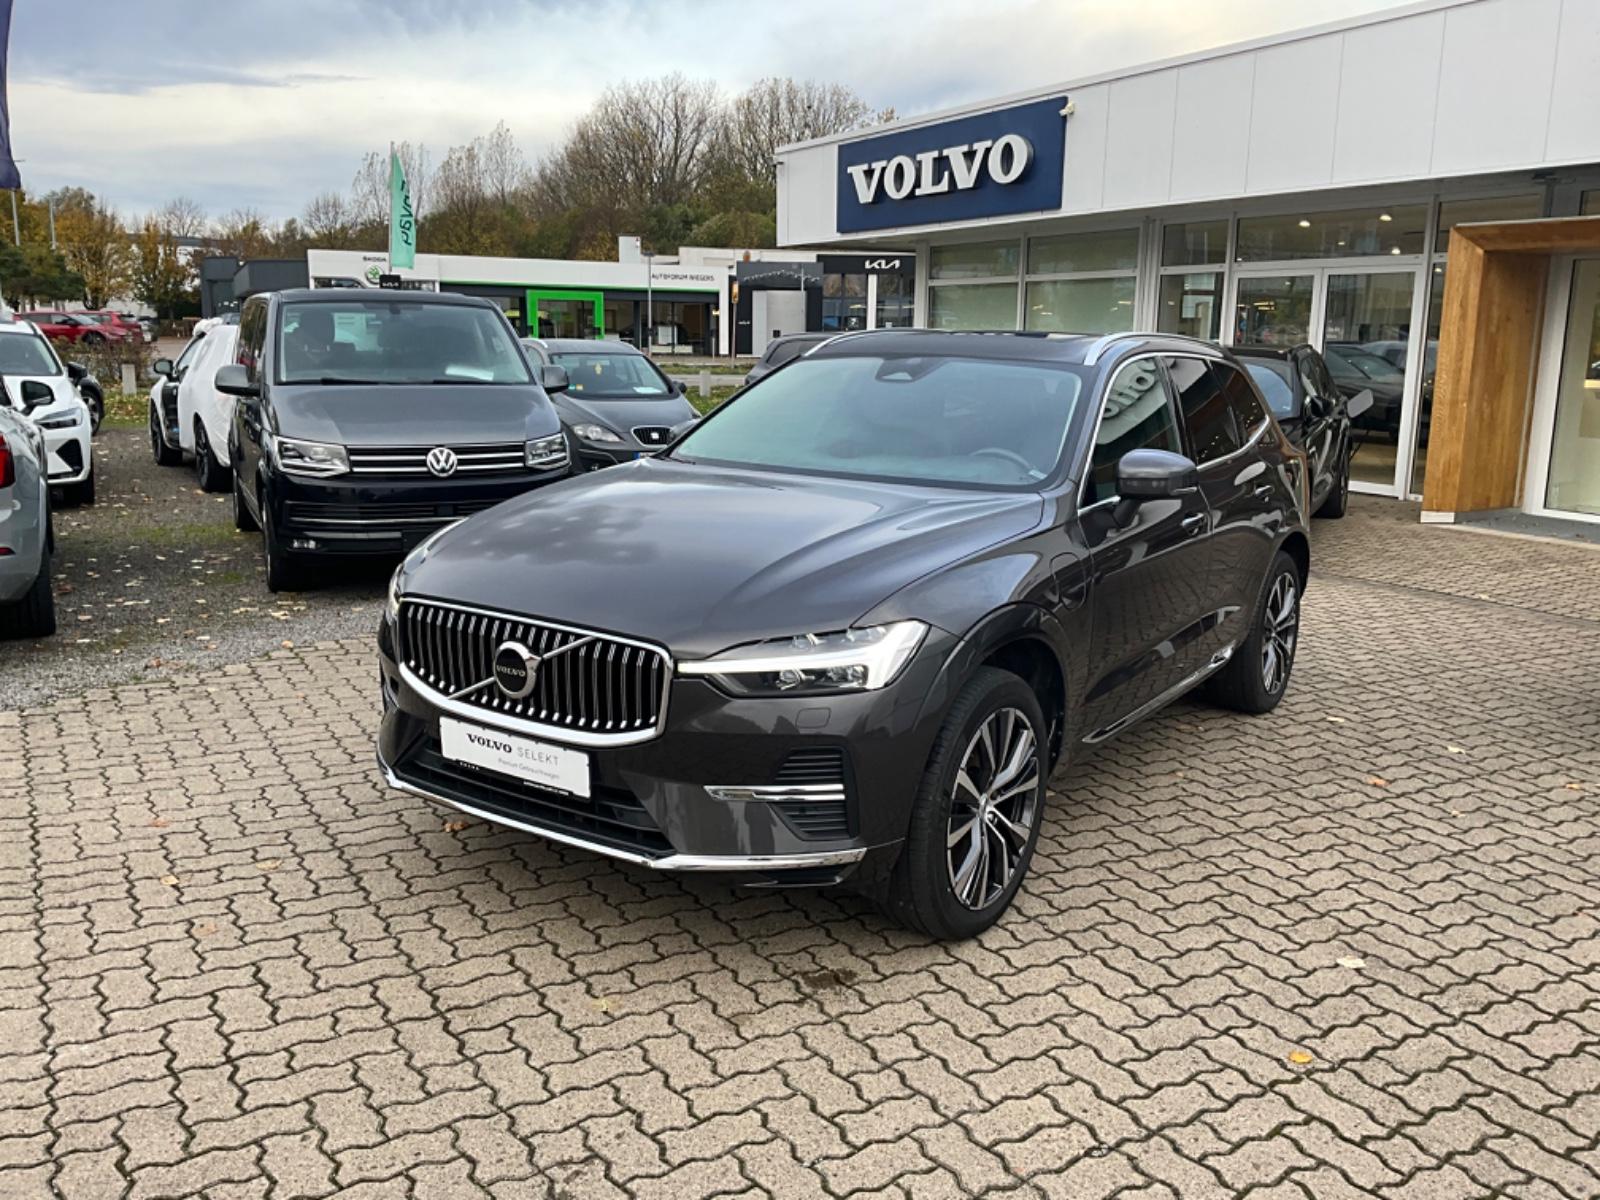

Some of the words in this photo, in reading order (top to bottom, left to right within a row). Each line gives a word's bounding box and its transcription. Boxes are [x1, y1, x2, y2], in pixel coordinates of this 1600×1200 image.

[847, 134, 1034, 204] VOLVO
[864, 259, 901, 269] KIA
[496, 664, 526, 677] VOLVO
[467, 733, 512, 754] VOLVO
[516, 746, 559, 766] SELEKT
